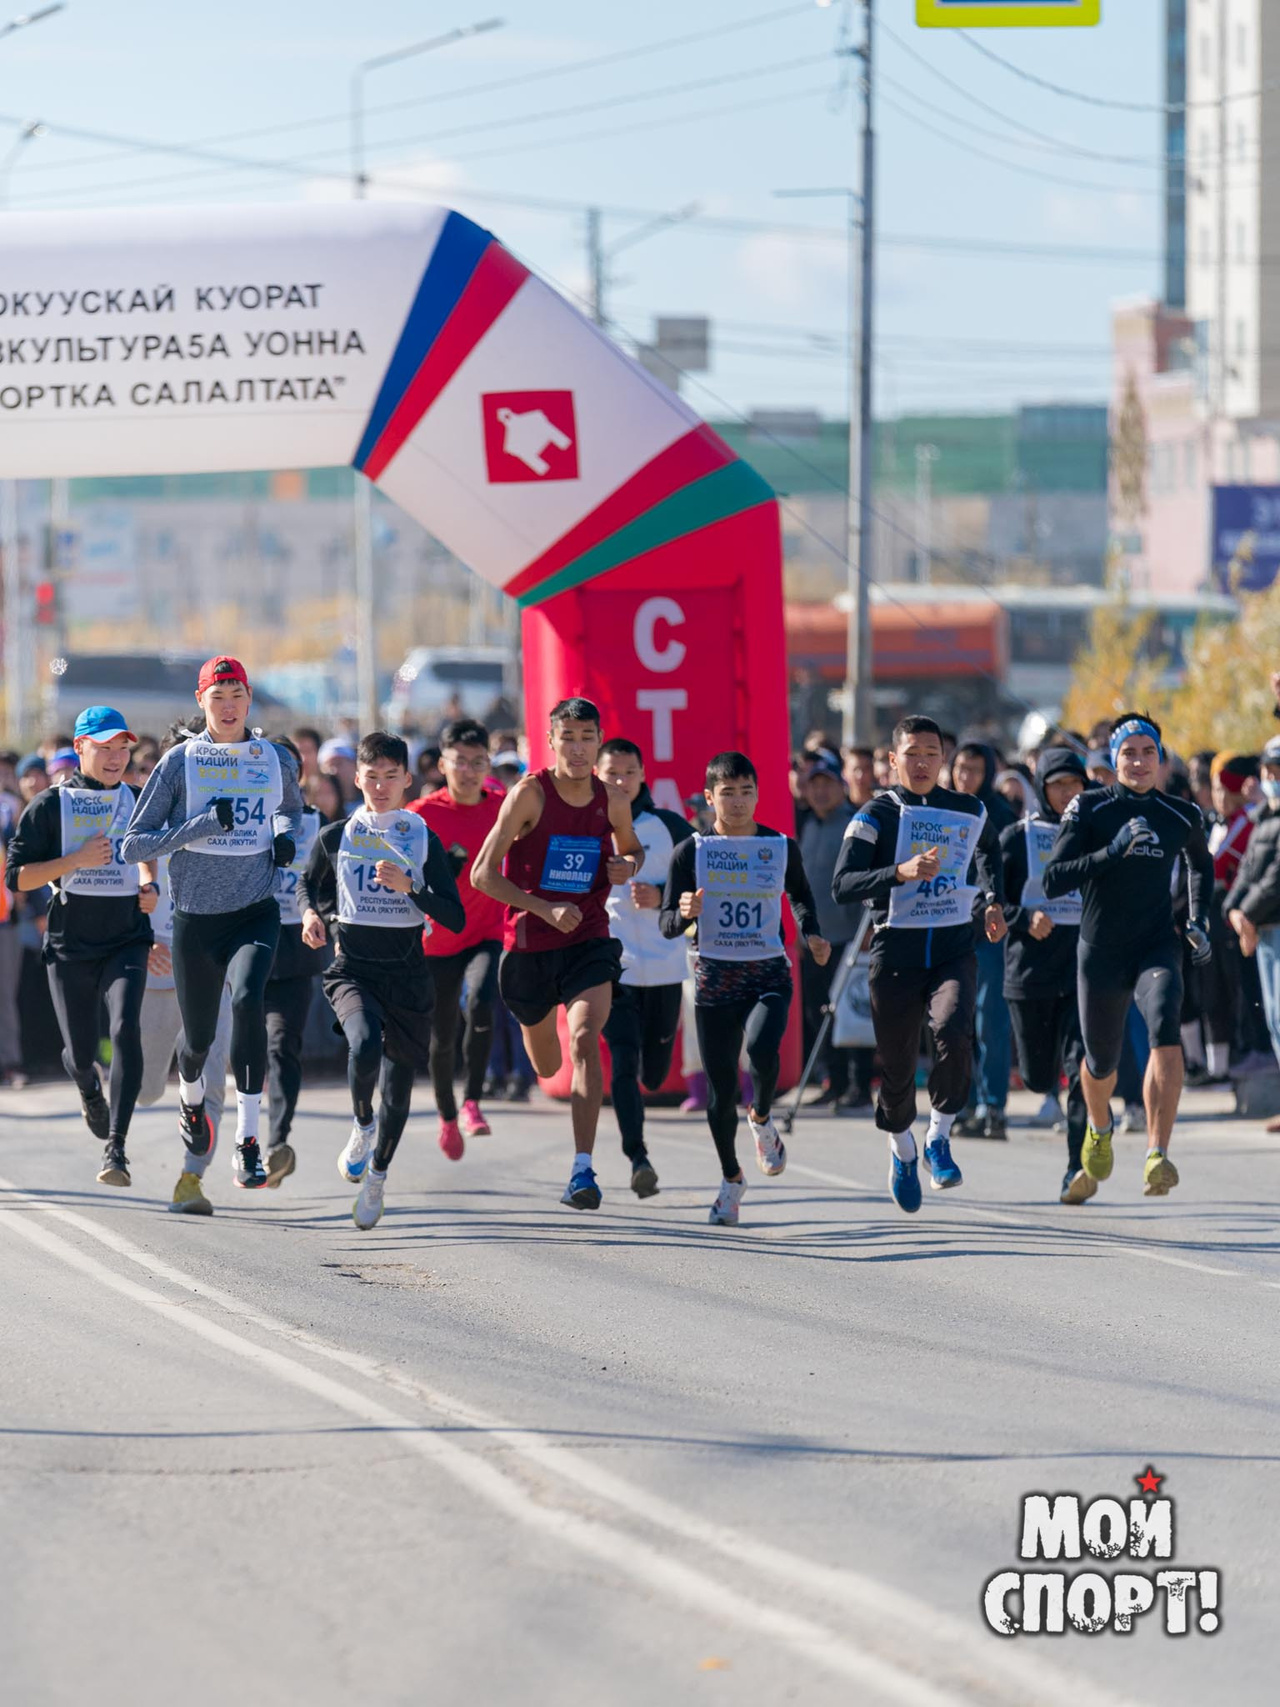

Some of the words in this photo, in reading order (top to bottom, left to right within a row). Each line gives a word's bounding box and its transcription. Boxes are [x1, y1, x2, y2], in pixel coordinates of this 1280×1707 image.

[195, 283, 325, 312] КУОРАТ
[245, 328, 367, 359] УОННА
[130, 376, 346, 407] САЛАЛТАТА”
[196, 746, 229, 756] КРОСС
[196, 758, 238, 767] НАЦИИ
[198, 767, 239, 779] 2022
[71, 796, 102, 806] КРОСС
[72, 805, 112, 815] НАЦИИ
[912, 821, 943, 833] КРОСС
[207, 838, 228, 846] САХА
[910, 832, 950, 844] НАЦИИ
[707, 850, 738, 860] КРОСС
[563, 853, 585, 870] 39
[707, 860, 748, 870] НАЦИИ
[73, 877, 92, 885] САХА
[353, 864, 412, 894] 15
[548, 869, 593, 883] НИКОЛАЕВ
[708, 870, 748, 884] 2022
[360, 896, 406, 906] РЕСПУБЛИКА
[357, 905, 376, 913] САХА
[378, 905, 411, 915] (ЯКУТИЯ)
[719, 901, 762, 929] 361
[714, 939, 733, 947] САХА
